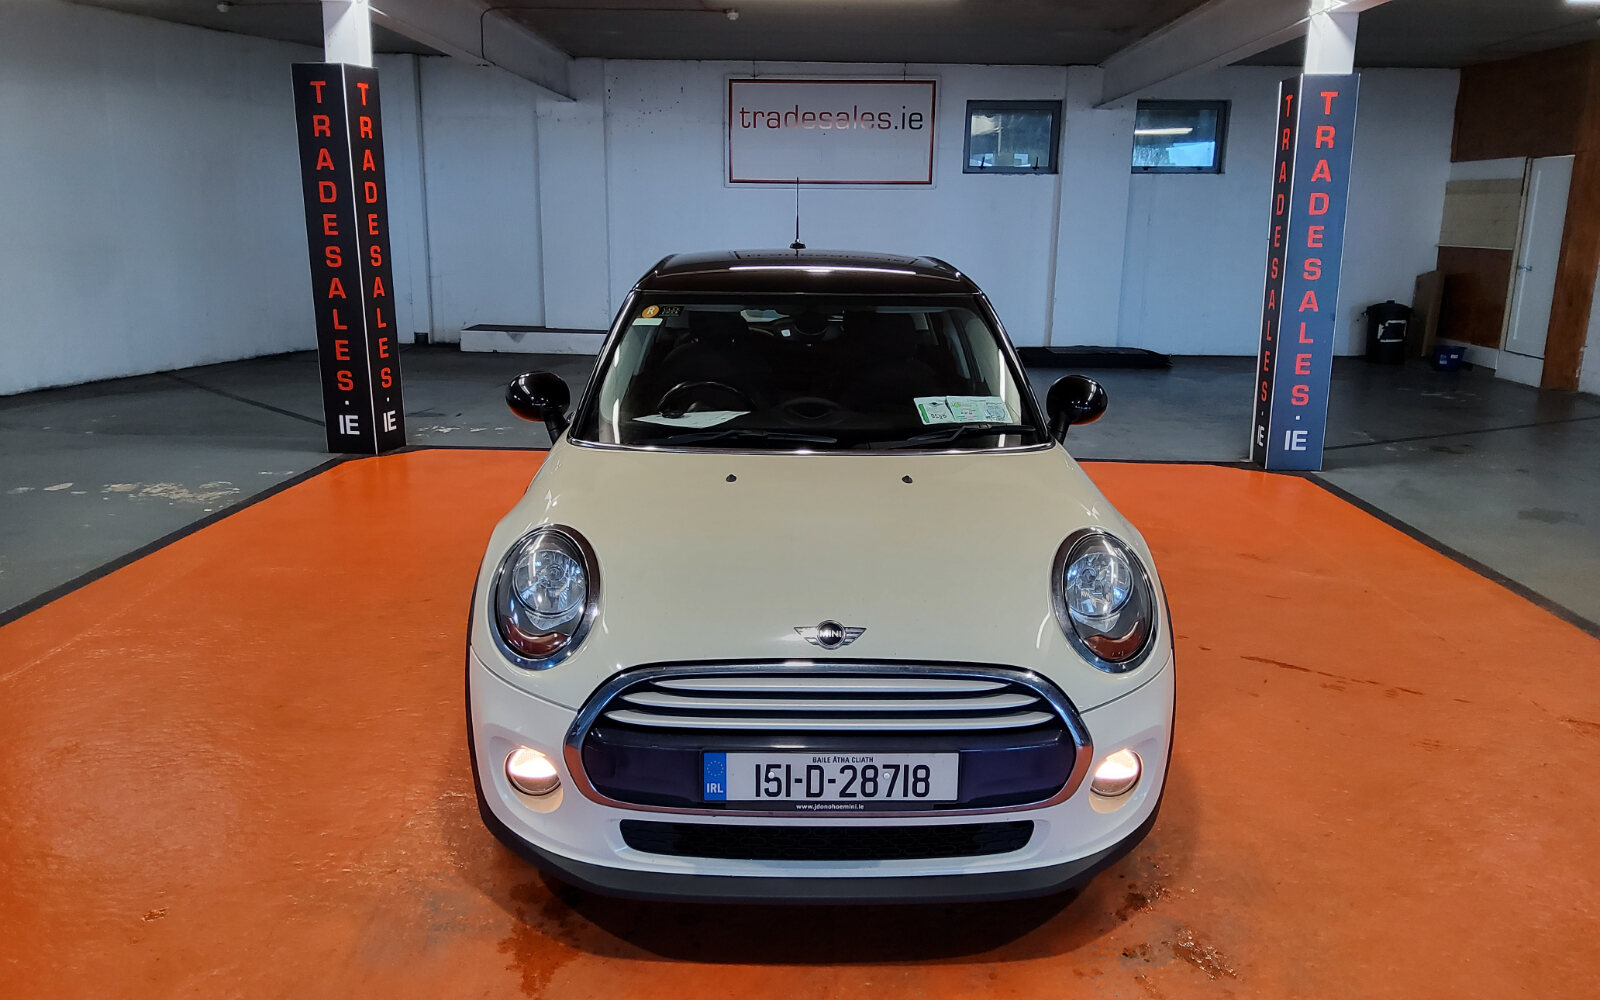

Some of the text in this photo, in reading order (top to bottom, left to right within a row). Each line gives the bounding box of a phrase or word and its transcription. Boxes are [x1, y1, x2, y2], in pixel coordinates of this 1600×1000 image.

[739, 105, 923, 130] tradesales.ie
[820, 629, 842, 638] MINI
[812, 756, 831, 764] BAILE
[851, 756, 874, 764] CLIATH
[754, 763, 931, 798] 151-D-28718
[706, 782, 724, 794] IRL
